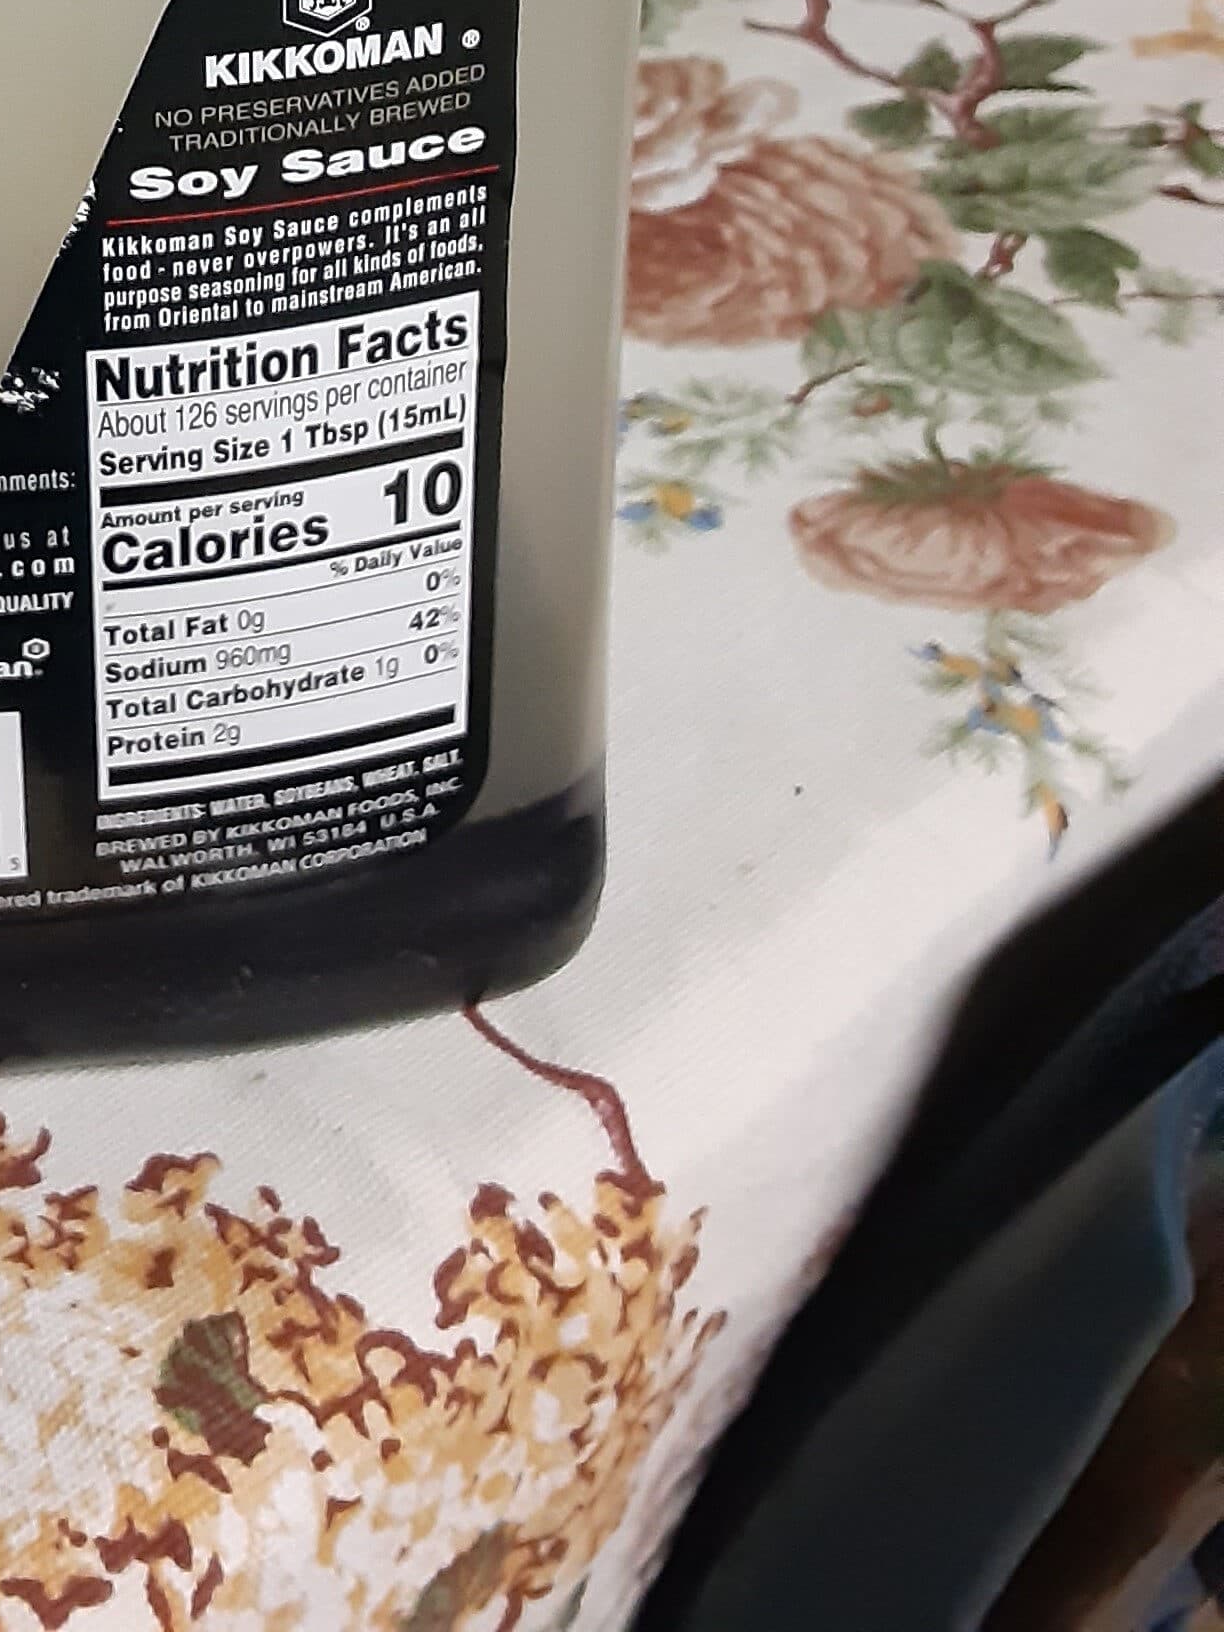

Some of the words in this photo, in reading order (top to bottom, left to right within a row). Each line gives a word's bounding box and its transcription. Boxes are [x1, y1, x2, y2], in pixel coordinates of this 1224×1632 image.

[205, 22, 443, 88] KIKKOMAN
[154, 108, 192, 129] NO
[201, 80, 399, 125] PRESERVATIVES
[405, 63, 485, 96] ADDED
[169, 111, 361, 153] TRADITIONALLY
[370, 92, 471, 126] BREWED
[129, 164, 258, 200] Soy
[281, 126, 486, 184] Sauce
[102, 233, 214, 257] Kikkoman
[224, 225, 263, 248] Soy
[273, 215, 339, 240] Sauce
[349, 184, 488, 228] complements
[102, 260, 151, 284] food
[172, 254, 235, 279] never
[243, 233, 376, 269] overpowers.
[385, 223, 419, 246] It's
[427, 217, 451, 237] an
[459, 205, 487, 228] all
[104, 285, 182, 311] purpose
[188, 272, 286, 300] seasoning
[291, 267, 318, 286] for
[323, 257, 348, 280] all
[353, 249, 402, 275] kinds
[407, 241, 426, 265] of
[104, 312, 151, 332] from
[158, 299, 239, 328] Oriental
[245, 298, 265, 317] to
[271, 279, 384, 313] mainstream
[389, 259, 482, 292] American.
[95, 340, 319, 402] Nutrition
[337, 310, 469, 369] Facts
[98, 408, 167, 439] About
[176, 401, 217, 432] 126
[225, 390, 319, 426] servings
[325, 380, 361, 413] per
[368, 360, 469, 400] container
[100, 446, 203, 477] Serving
[213, 434, 271, 464] Size
[281, 432, 293, 453] 1
[305, 419, 369, 451] Tbsp
[378, 393, 467, 440] (15mL)
[100, 506, 181, 530] Amount
[189, 502, 223, 523] per
[229, 488, 305, 516] serving
[383, 460, 463, 525] 10
[3, 531, 31, 550] us
[46, 525, 71, 548] at
[103, 513, 329, 574] Calories
[354, 550, 403, 573] Daily
[409, 538, 463, 560] Value
[426, 568, 461, 591] 0%
[104, 620, 176, 647] Total
[186, 611, 229, 637] Fat
[237, 610, 265, 633] 0g
[408, 605, 461, 630] 42%
[105, 655, 207, 684] Sodium
[215, 643, 292, 670] 960mg
[106, 695, 176, 721] Total
[186, 663, 365, 710] Carbohydrate
[375, 656, 400, 681] 1g
[107, 729, 206, 757] Protein
[213, 724, 241, 747] 2g
[96, 833, 187, 857] BREWED
[192, 827, 221, 845] BY
[225, 807, 343, 838] KIKKOMAN
[266, 834, 296, 853] WI
[46, 879, 157, 906] trademark
[161, 875, 185, 895] of
[191, 858, 297, 891] KIKKOMAN
[299, 828, 428, 870] CORPORATION
